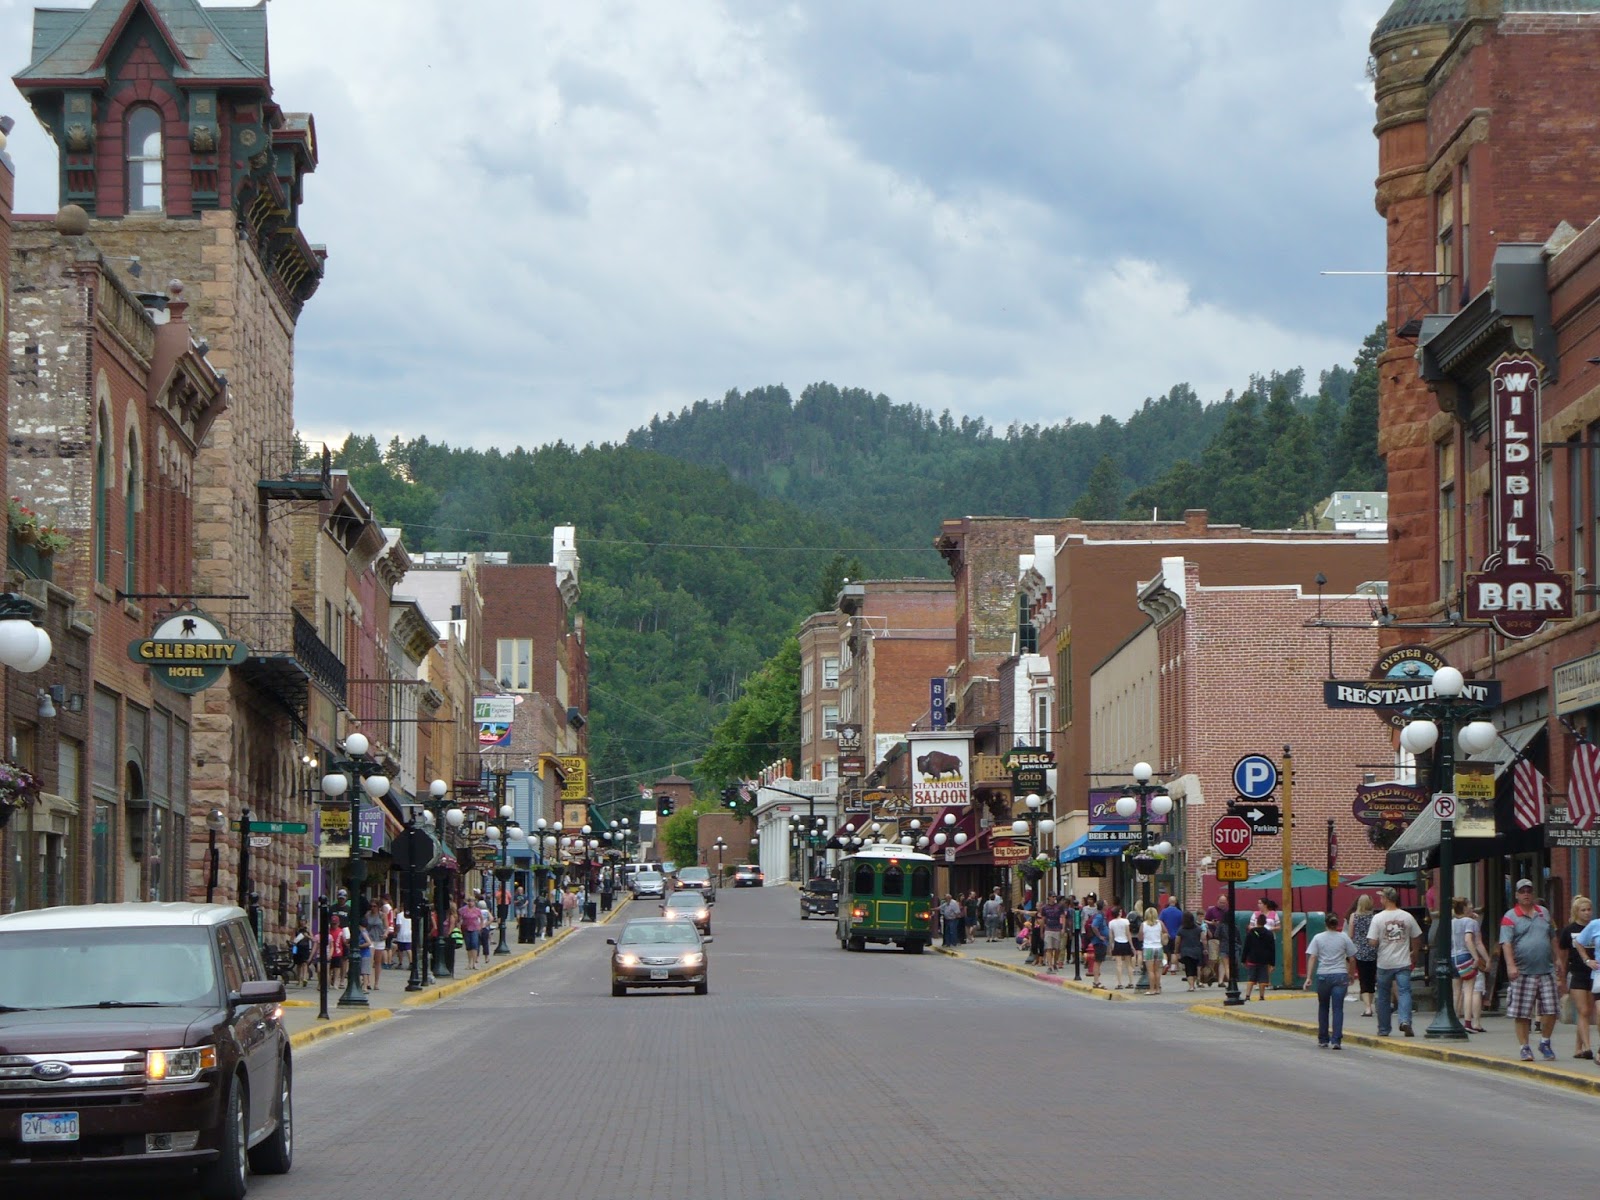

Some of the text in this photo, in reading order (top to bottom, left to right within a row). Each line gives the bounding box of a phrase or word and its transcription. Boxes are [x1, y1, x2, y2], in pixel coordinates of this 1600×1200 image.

[1504, 372, 1531, 566] WILD BILL
[1478, 582, 1563, 611] BAR
[140, 641, 236, 660] CELEBRITY
[1380, 648, 1421, 671] OYSTER
[168, 666, 205, 678] HOTEL
[1337, 684, 1488, 706] RESTAURNT
[838, 739, 860, 747] ELKS
[1009, 754, 1050, 763] BERG
[913, 781, 968, 789] STEAKHOUSE
[915, 789, 968, 804] SALOON
[1362, 788, 1425, 804] DEADWOOD
[1368, 803, 1406, 811] TOBACCO
[1253, 824, 1278, 834] Parking
[1088, 832, 1142, 840] BEER & BLING
[1215, 828, 1249, 844] STOP
[1556, 838, 1583, 846] AUGUST
[995, 846, 1028, 857] Big Dipper
[1224, 861, 1241, 869] PED
[1222, 870, 1242, 878] XING
[40, 1064, 63, 1075] Ford
[24, 1119, 76, 1135] 2VL 810
